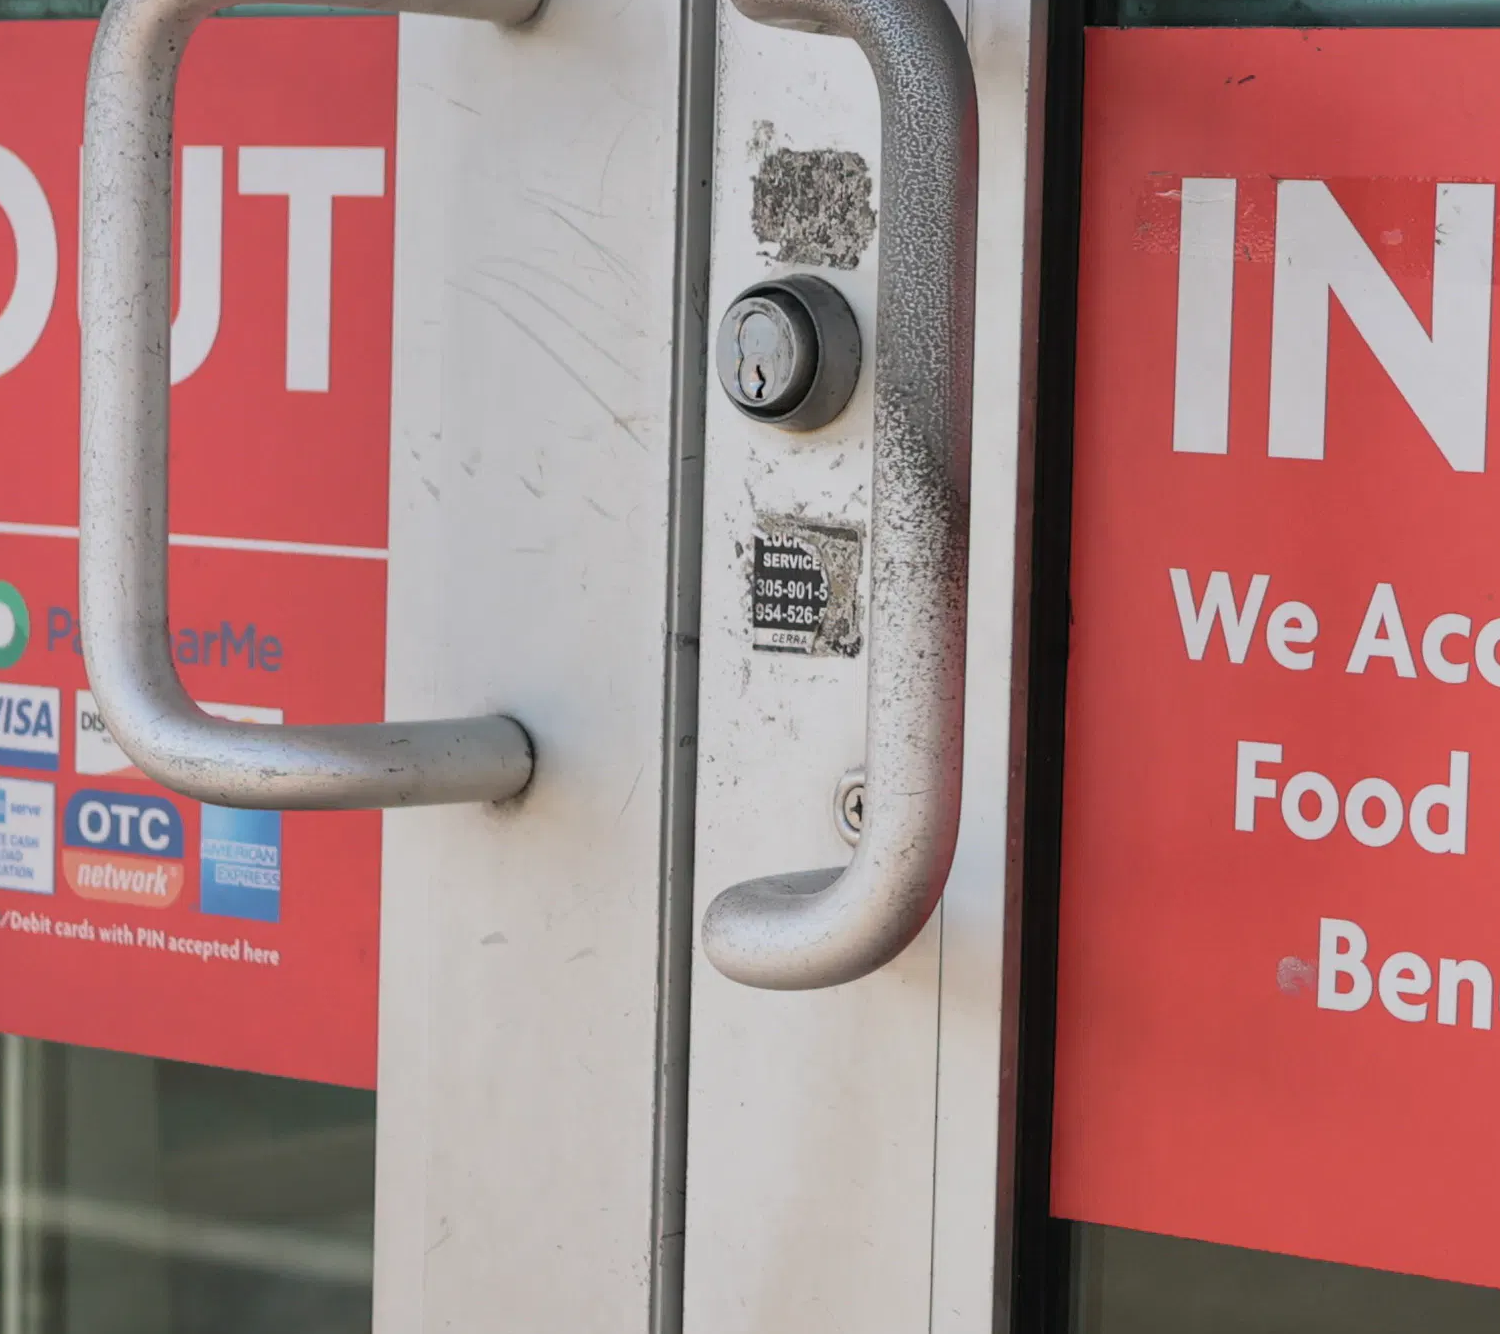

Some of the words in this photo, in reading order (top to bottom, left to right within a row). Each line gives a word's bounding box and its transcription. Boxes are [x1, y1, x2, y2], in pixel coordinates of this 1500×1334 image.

[1173, 177, 1495, 473] IN
[763, 552, 820, 571] SERVICE
[47, 606, 283, 673] ParMe
[1169, 568, 1319, 670] We
[1234, 740, 1470, 856] Food
[79, 800, 171, 851] OTC
[77, 862, 169, 897] network
[216, 865, 280, 887] EXPRESS
[55, 919, 95, 942] cards
[99, 923, 133, 947] with
[137, 928, 165, 951] PIN
[168, 933, 240, 963] accepted
[244, 940, 280, 966] here
